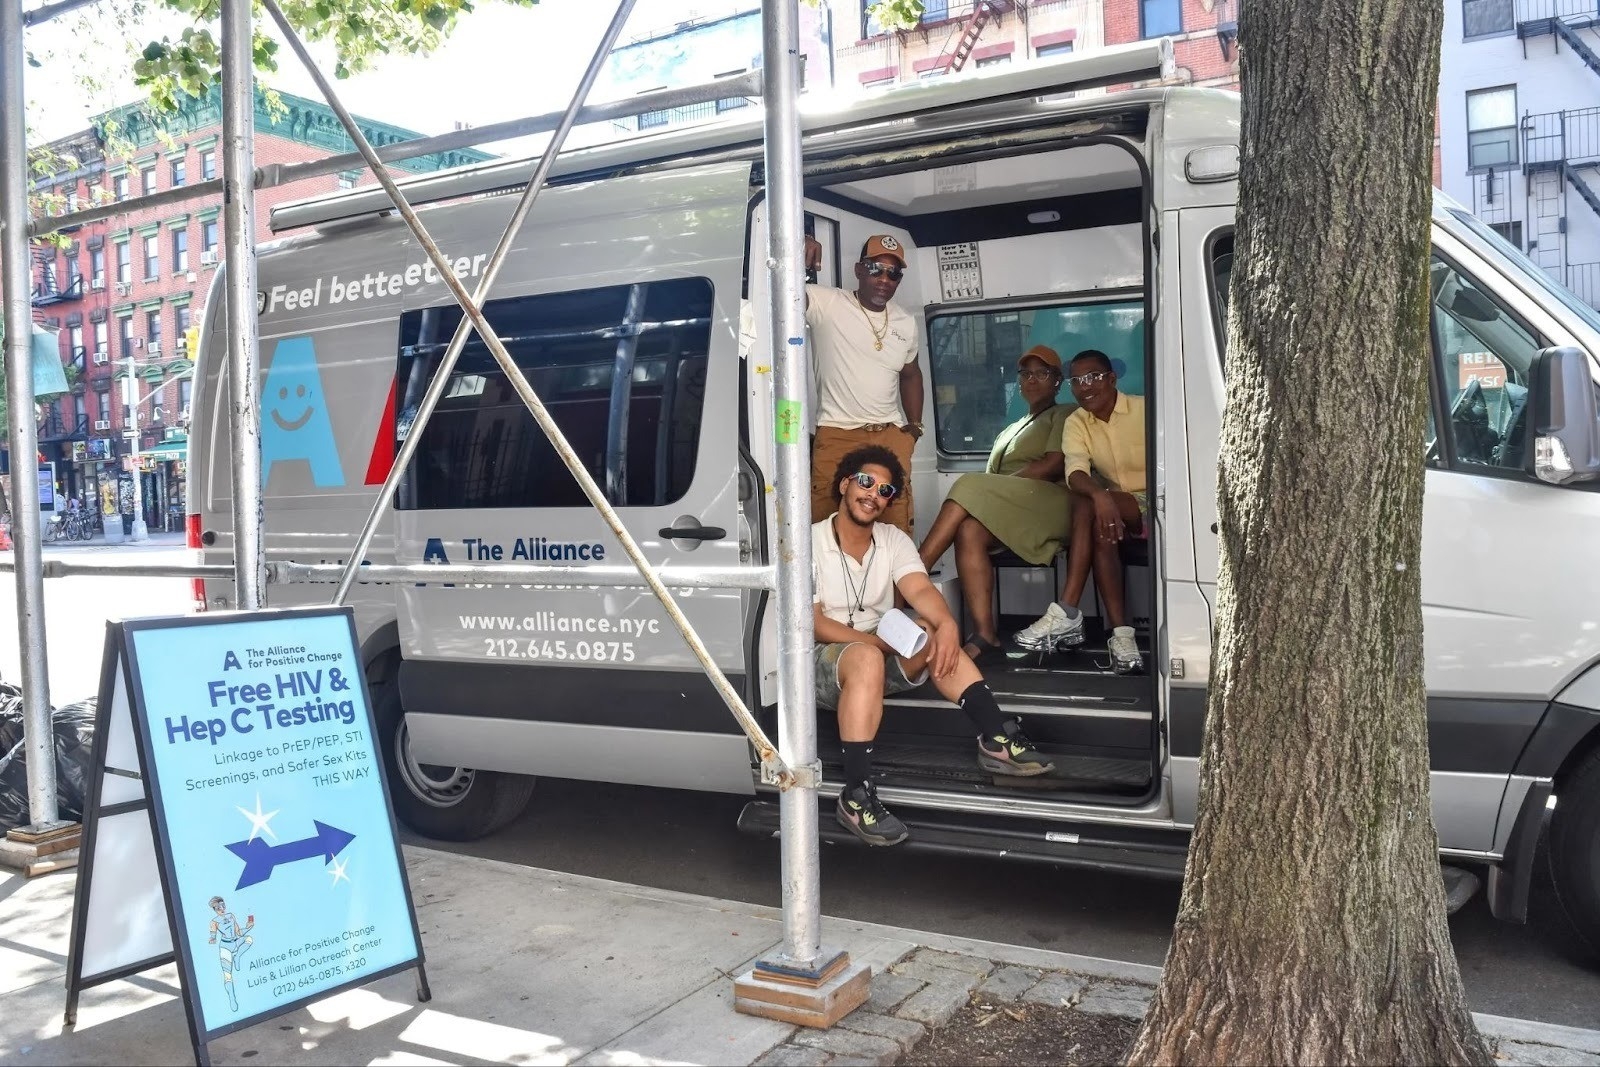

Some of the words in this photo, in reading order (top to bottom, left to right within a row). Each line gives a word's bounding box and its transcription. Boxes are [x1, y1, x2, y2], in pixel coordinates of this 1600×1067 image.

[269, 279, 322, 312] Feel
[463, 538, 503, 561] The
[511, 538, 605, 561] Alliance
[459, 611, 660, 638] www.alliance.nyc
[246, 647, 264, 658] The
[267, 645, 306, 657] Alliance
[248, 658, 264, 669] for
[265, 655, 305, 668] Positive
[307, 651, 343, 664] Change
[484, 639, 636, 662] 212.645.0875
[207, 680, 272, 708] Free
[275, 669, 323, 699] HIV
[329, 667, 350, 692] &
[165, 714, 227, 746] Hep
[231, 707, 254, 734] C
[256, 696, 356, 730] Testing
[214, 745, 264, 766] Linkage
[266, 747, 280, 758] to
[282, 735, 343, 755] PrEP/PEP,
[345, 731, 364, 743] STI
[185, 769, 259, 792] Screenings,
[262, 763, 285, 778] and
[287, 757, 320, 775] Safer
[322, 755, 344, 768] Sex
[345, 749, 367, 762] Kits
[312, 772, 341, 788] THIS
[343, 767, 371, 782] WAY
[247, 973, 268, 989] Luis
[269, 971, 277, 981] &
[279, 962, 307, 978] Lillian
[308, 949, 351, 969] Outreach
[352, 938, 383, 955] Center
[249, 953, 287, 972] Alliance
[288, 946, 304, 958] for
[304, 935, 341, 951] Positive
[341, 924, 376, 942] Change
[272, 980, 297, 998] (212)
[298, 965, 344, 989] 645-0875,
[345, 957, 367, 973] x320
